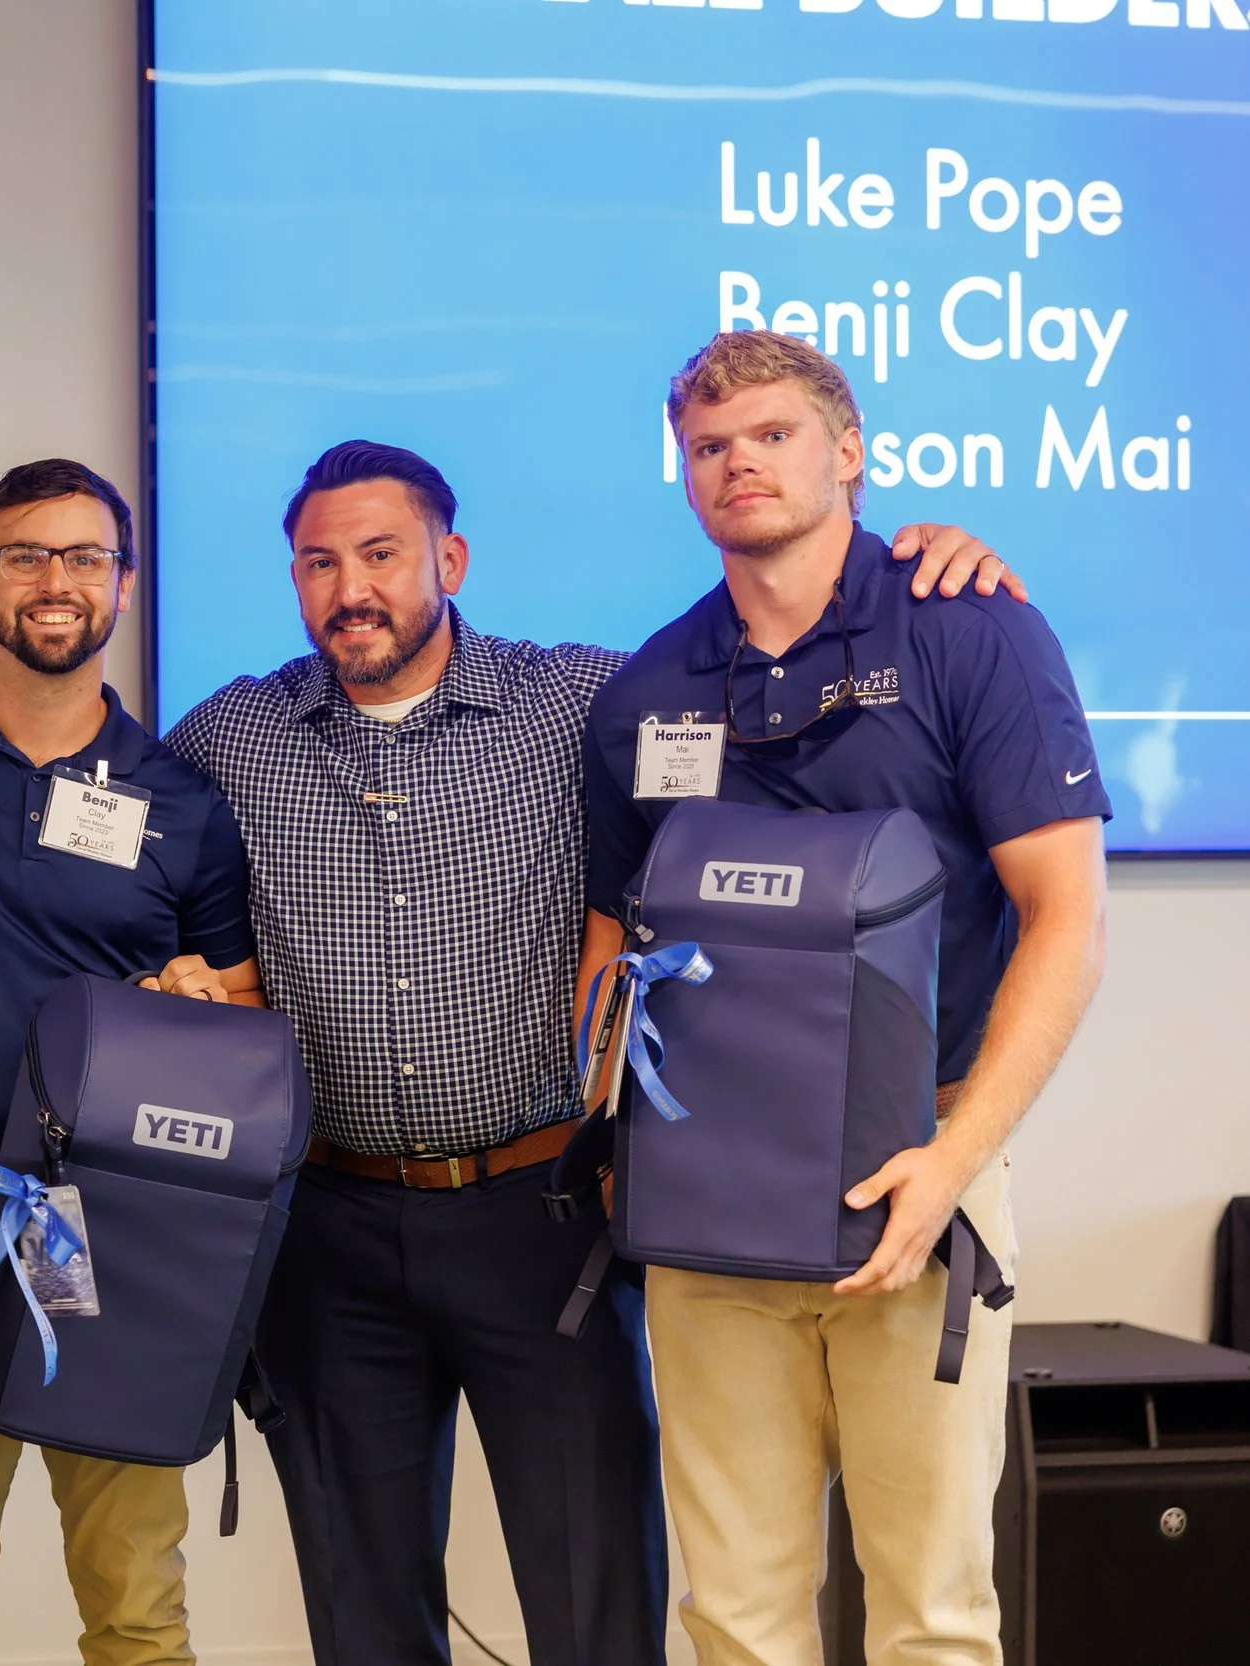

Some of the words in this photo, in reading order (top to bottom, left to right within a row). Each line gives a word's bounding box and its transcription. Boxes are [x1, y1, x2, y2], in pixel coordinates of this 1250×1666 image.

[720, 137, 894, 229] Luke
[926, 148, 1123, 258] Pope
[719, 271, 910, 383] Benji
[940, 271, 1128, 387] Clay
[1036, 404, 1191, 490] Mai
[853, 676, 899, 692] YEARS
[654, 728, 712, 741] Harrison
[660, 775, 678, 793] 50
[81, 791, 119, 813] Benji
[88, 808, 107, 820] Clay
[67, 832, 89, 848] 50
[90, 839, 115, 851] YEARS
[143, 829, 163, 839] omes
[712, 869, 793, 897] YETI
[145, 1112, 223, 1150] YETI
